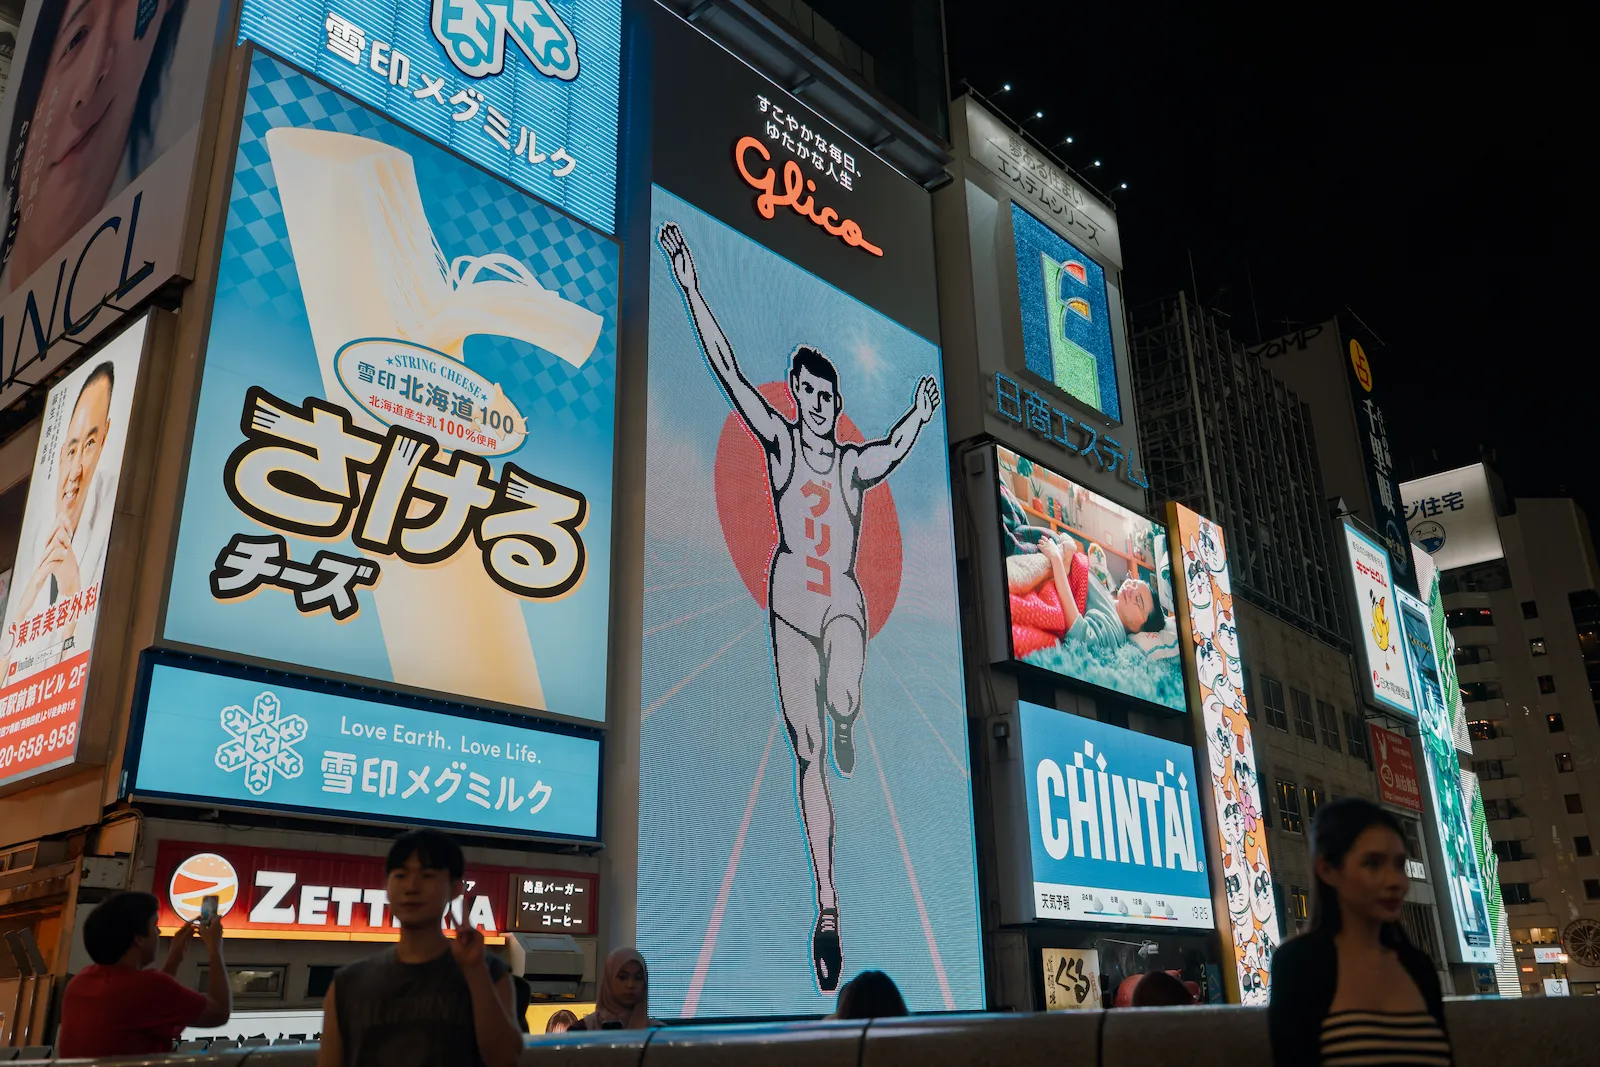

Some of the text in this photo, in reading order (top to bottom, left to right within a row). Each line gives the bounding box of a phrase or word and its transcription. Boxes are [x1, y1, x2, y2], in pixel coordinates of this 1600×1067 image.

[325, 11, 577, 178] 雪印メグミルク
[757, 94, 862, 178] すこやかな毎日、
[766, 121, 853, 192] ゆたかな人生
[1008, 135, 1085, 207] 夢ある住まい
[735, 136, 884, 257] Glico
[997, 154, 1102, 246] エステムシリーズ
[0, 190, 155, 393] NCL
[394, 354, 482, 399] STRING CHEESE
[368, 394, 498, 450] 北海道産生乳100%使用
[995, 371, 1149, 490] 日商エステム
[223, 385, 587, 598] さける
[800, 479, 832, 597] グリコ
[209, 533, 380, 620] チーズ
[16, 582, 99, 648] 東京美容外科
[68, 662, 88, 690] 2F
[340, 715, 542, 765] Love Earth. Love Life.
[321, 749, 553, 815] 雪印メグミルク
[1036, 740, 1198, 872] CHINTAI
[249, 870, 498, 932] ZETTIA
[521, 901, 572, 913] フェアトレード
[523, 880, 583, 896] 絶品バーガー
[542, 915, 583, 927] コーヒー
[1041, 893, 1071, 911] 天気予報
